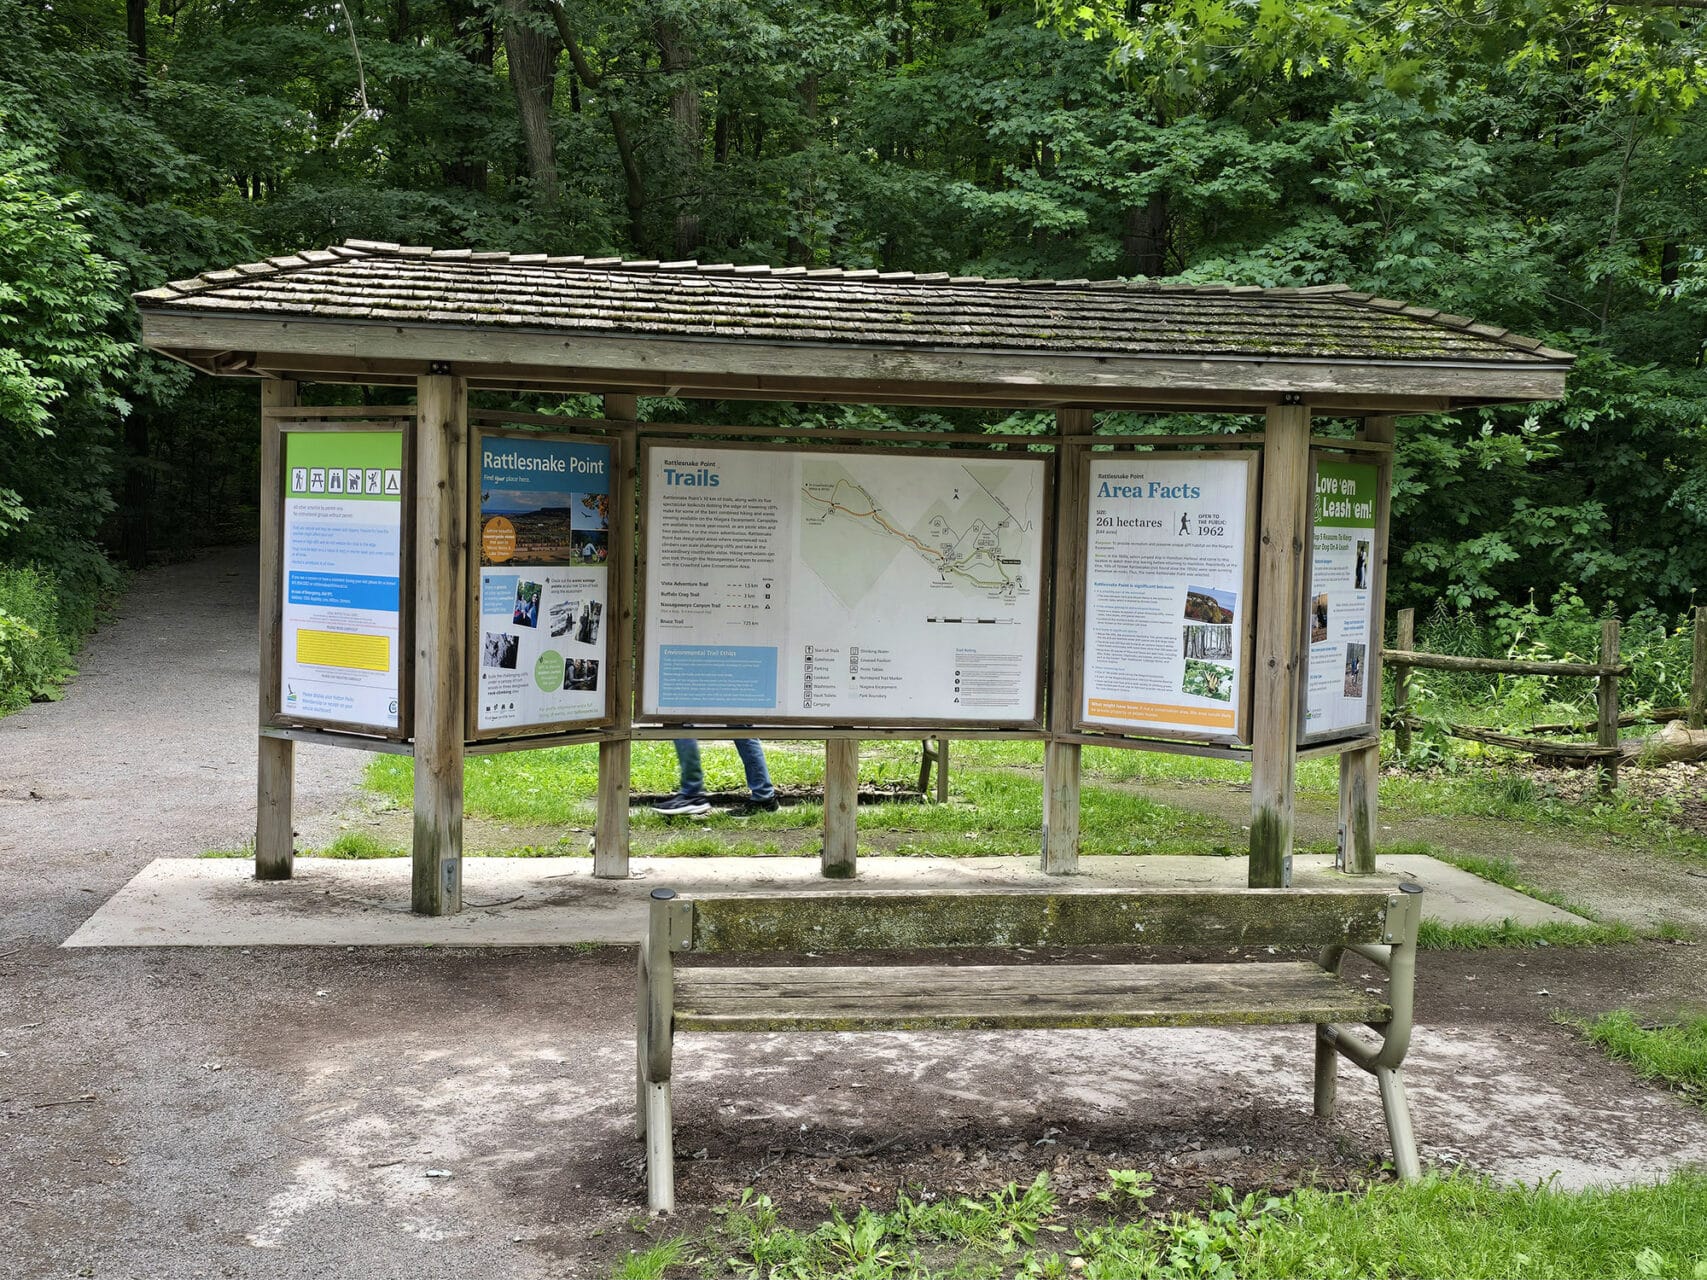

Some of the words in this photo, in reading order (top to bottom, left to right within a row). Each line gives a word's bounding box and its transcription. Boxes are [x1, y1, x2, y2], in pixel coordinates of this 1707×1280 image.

[484, 451, 565, 472] Rattlesnake
[570, 457, 604, 474] Point
[664, 469, 719, 487] Trails
[1316, 473, 1337, 493] Love
[1097, 482, 1143, 498] Area
[1148, 482, 1200, 498] Facts
[1323, 497, 1351, 518] Leash
[1096, 517, 1113, 527] 261
[1117, 517, 1162, 527] hectares
[1198, 527, 1224, 536] 1962
